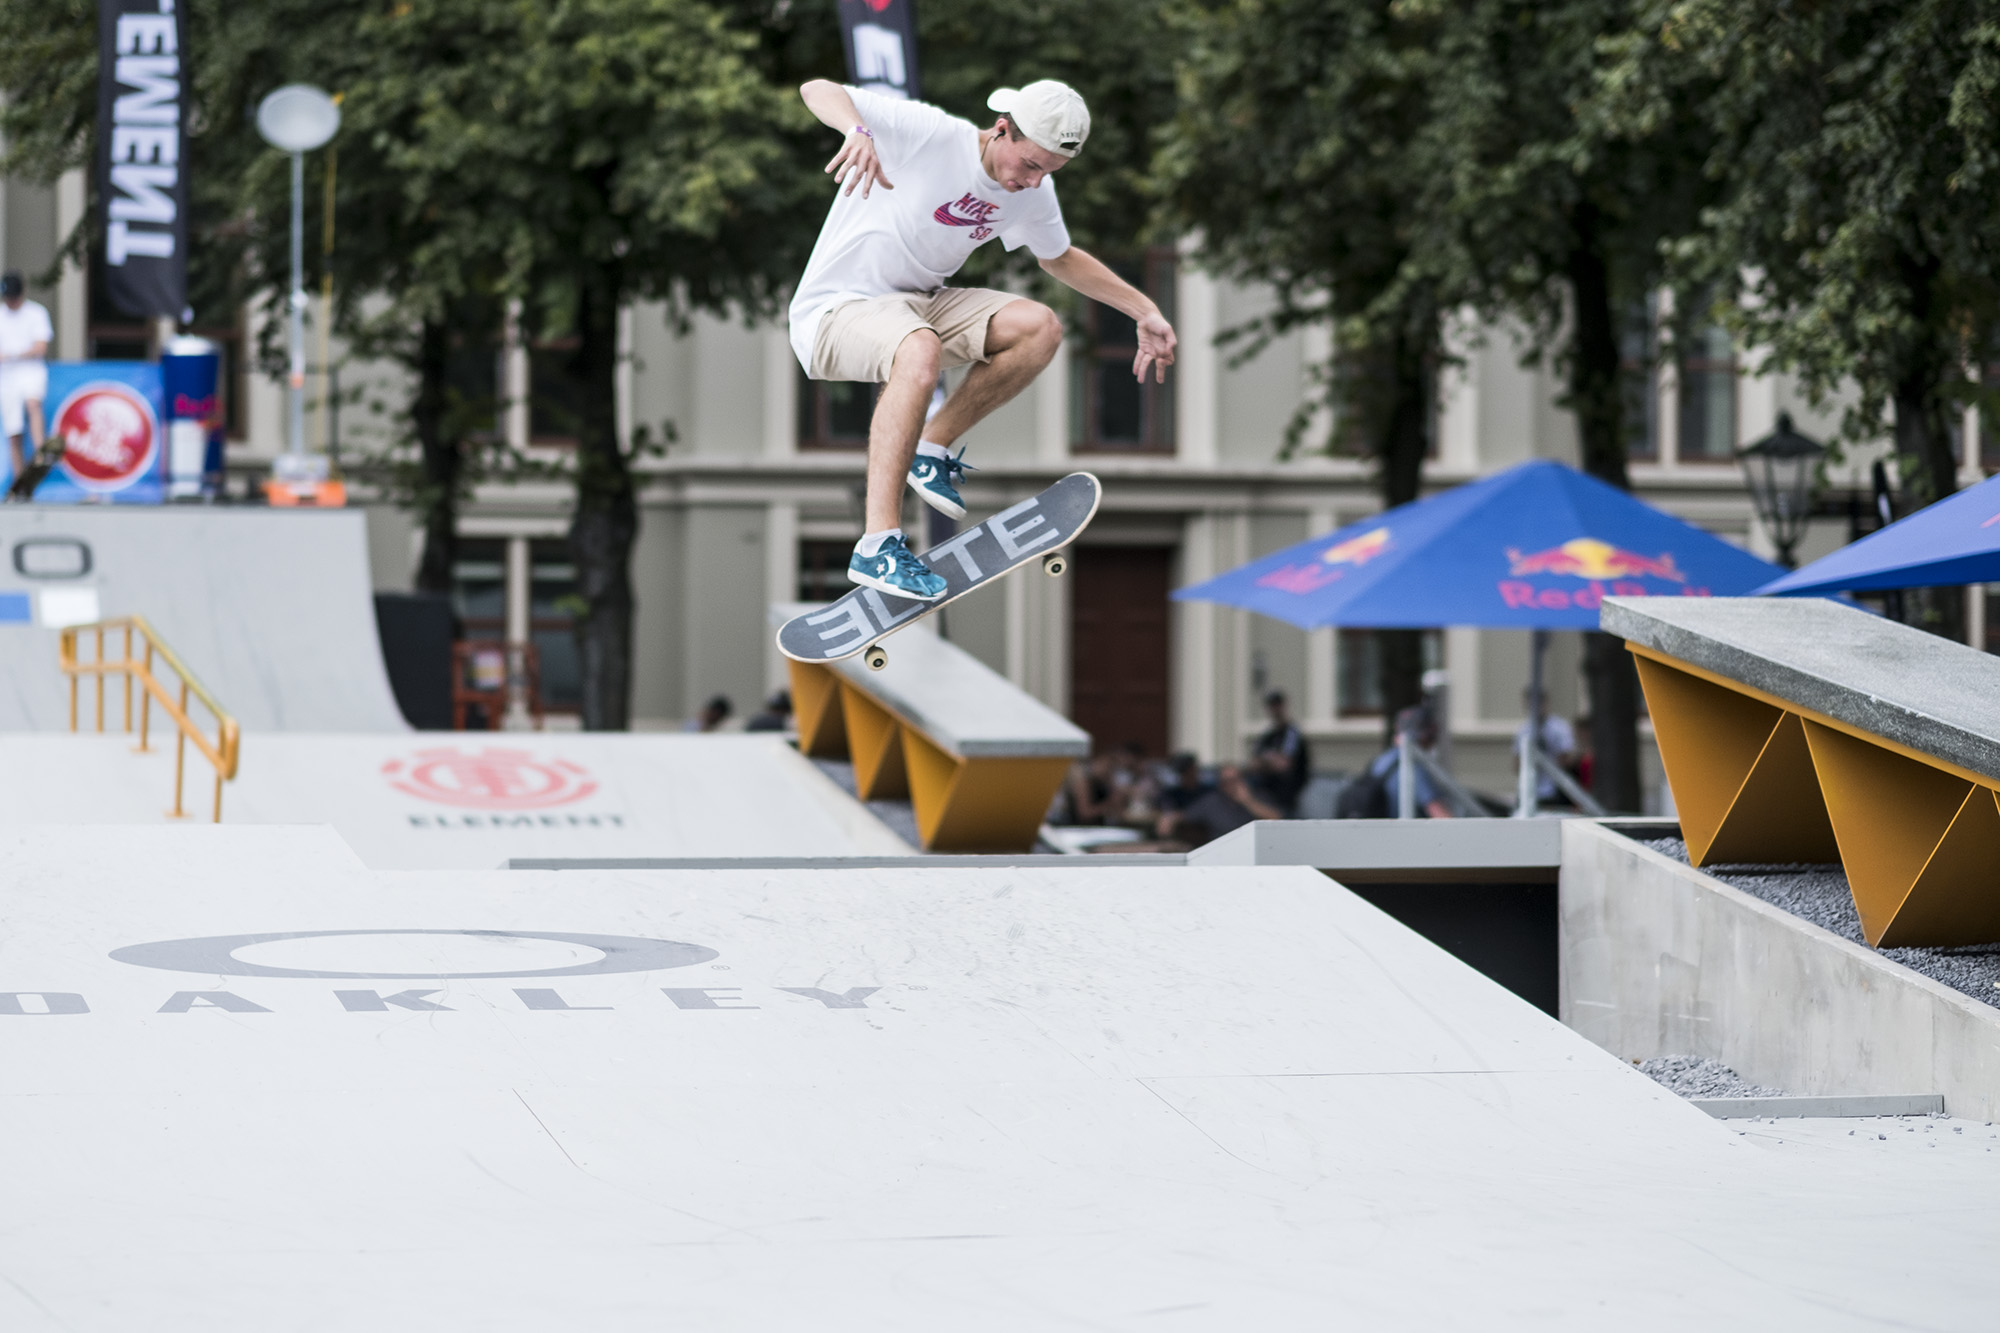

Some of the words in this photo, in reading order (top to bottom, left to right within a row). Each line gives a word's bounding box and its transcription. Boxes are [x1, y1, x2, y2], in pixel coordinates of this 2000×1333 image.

[953, 192, 1000, 220] NIKE
[968, 225, 993, 241] SB
[805, 497, 1060, 658] ELTE
[407, 813, 625, 829] ELEMENT
[0, 987, 884, 1015] OAKLEY
